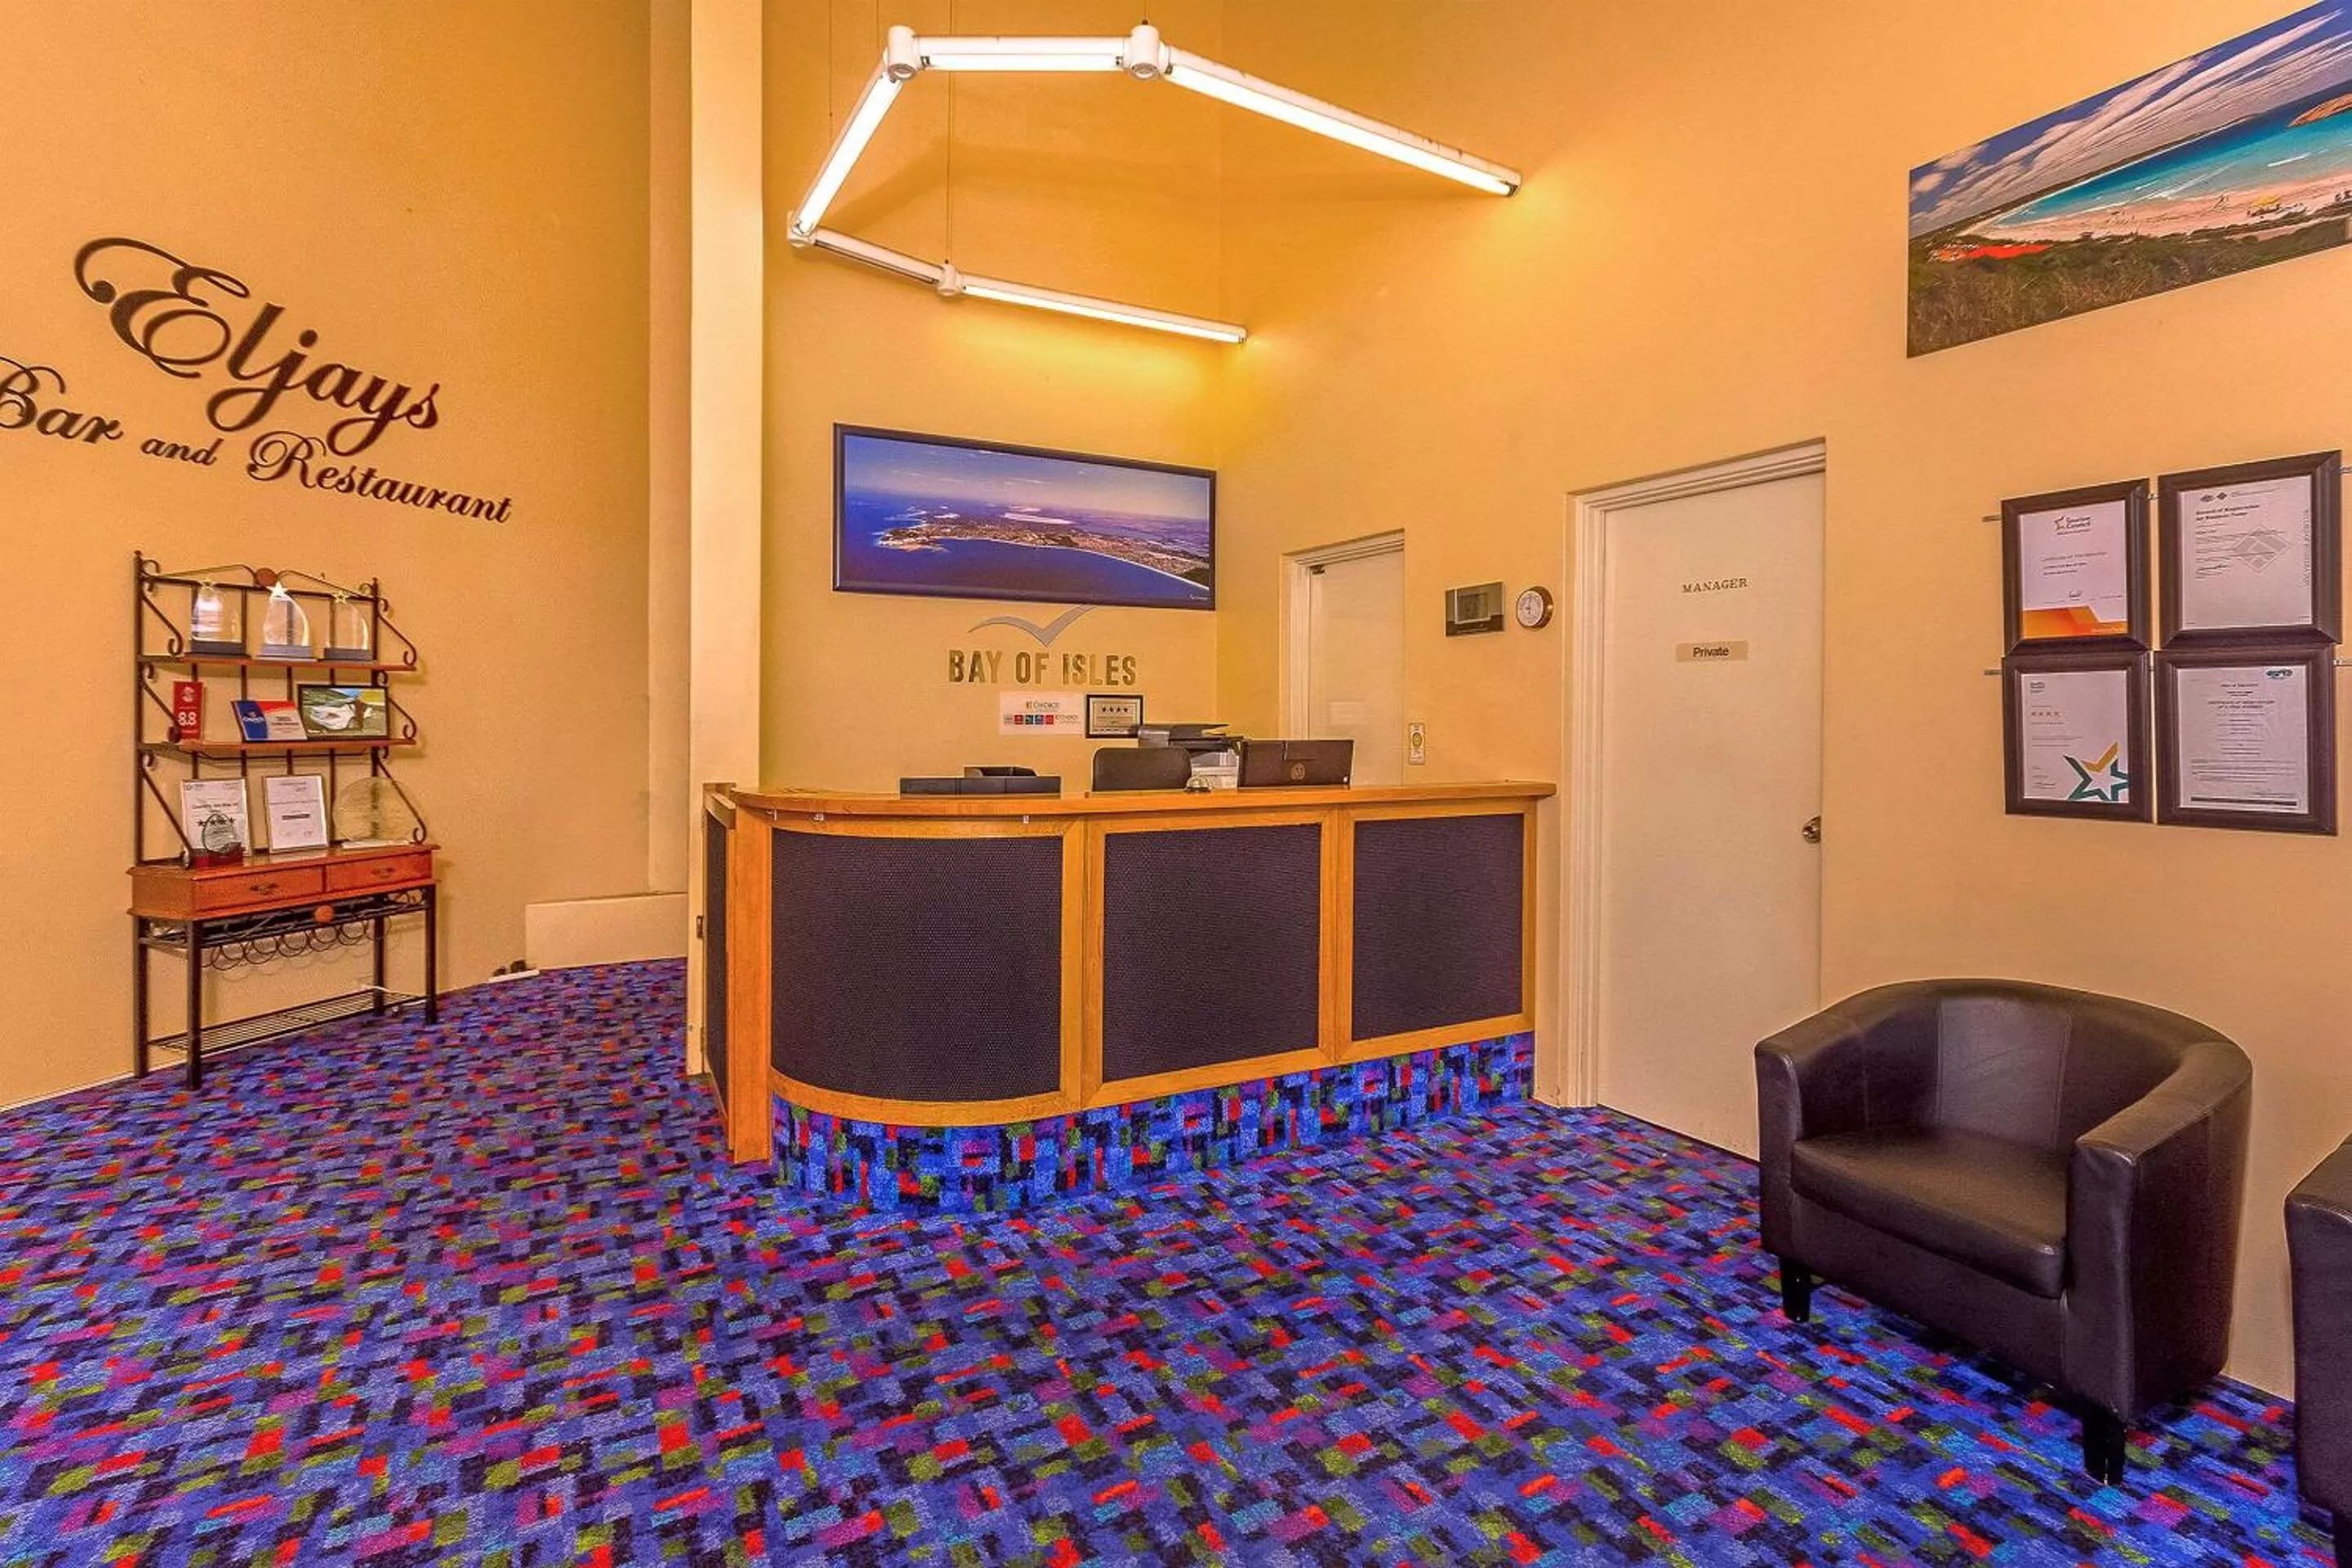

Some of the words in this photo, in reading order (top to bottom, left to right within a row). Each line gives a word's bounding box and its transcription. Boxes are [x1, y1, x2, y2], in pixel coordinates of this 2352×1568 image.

[74, 237, 440, 457] Eljays
[0, 356, 123, 444] Bar
[140, 438, 225, 466] and
[246, 430, 512, 523] Restaurant
[1682, 577, 1748, 593] MANAGER
[948, 650, 1003, 683] BAY
[1015, 652, 1049, 684] OF
[1062, 653, 1137, 686] ISLES
[1692, 646, 1730, 657] Private
